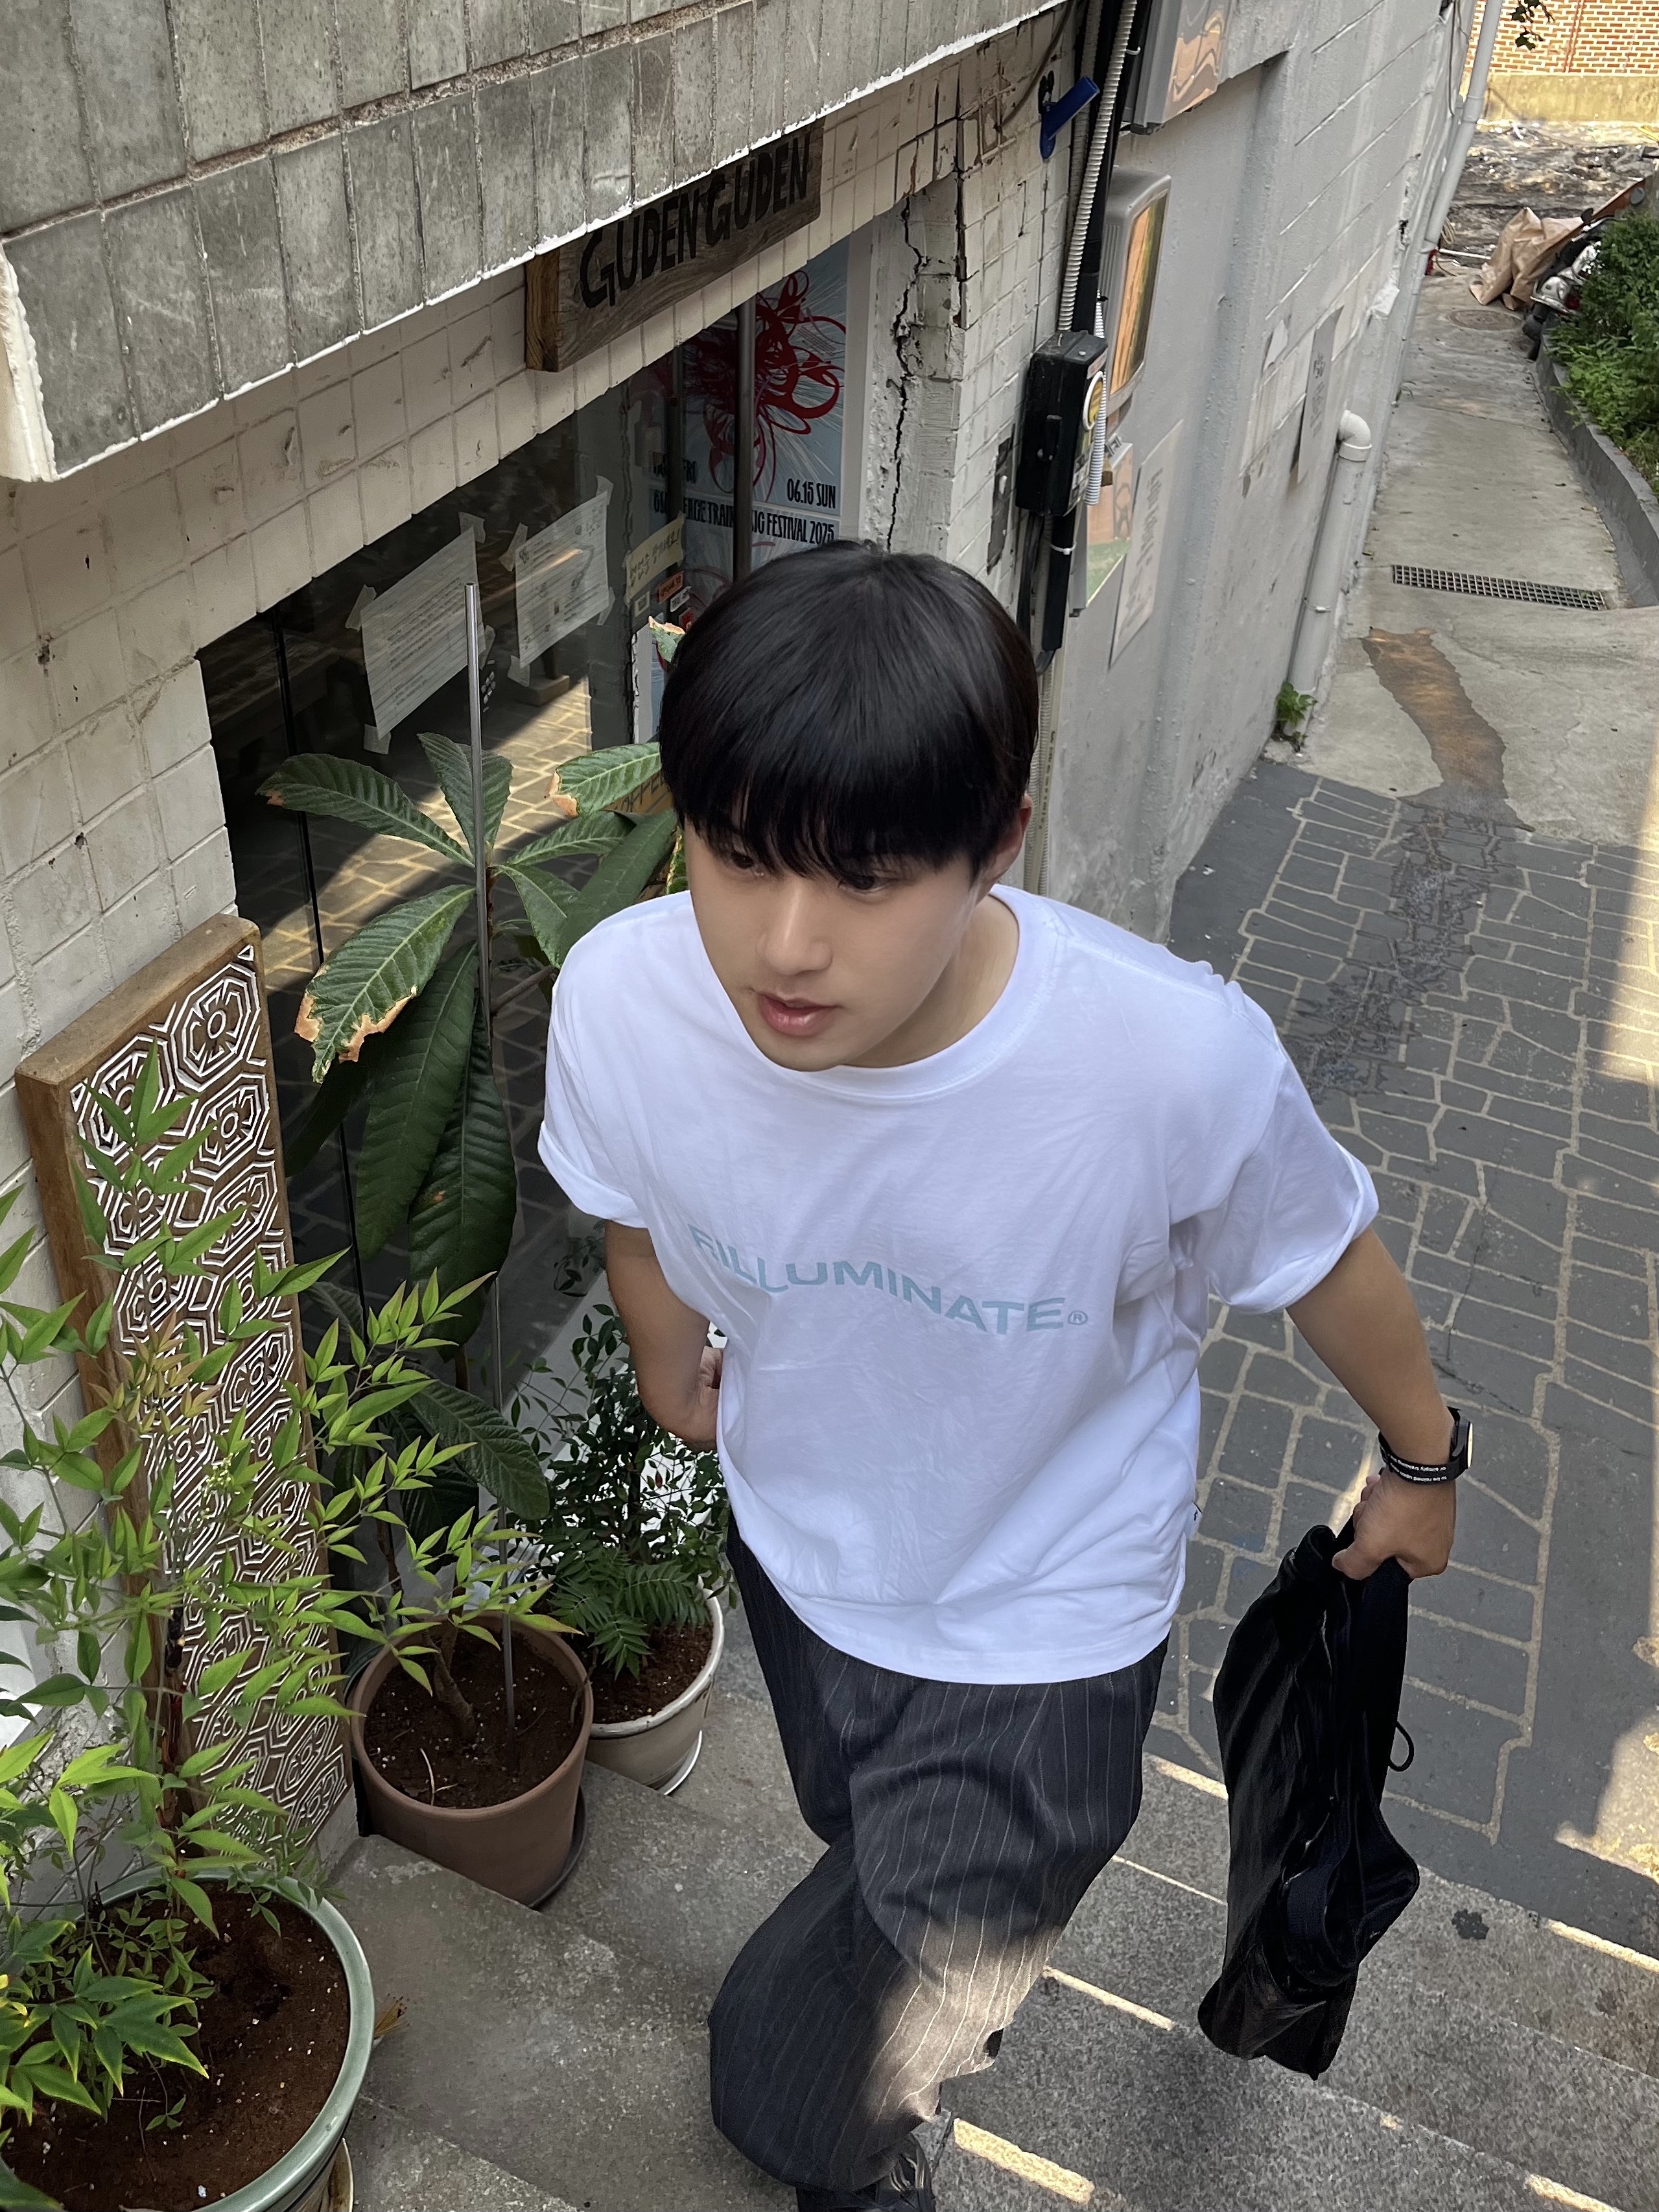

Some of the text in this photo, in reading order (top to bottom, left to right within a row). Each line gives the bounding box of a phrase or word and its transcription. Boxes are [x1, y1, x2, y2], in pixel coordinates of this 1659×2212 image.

[580, 187, 700, 309] GUDEN
[786, 478, 836, 509] 06.15 SUN
[766, 512, 808, 543] FESTIVAL
